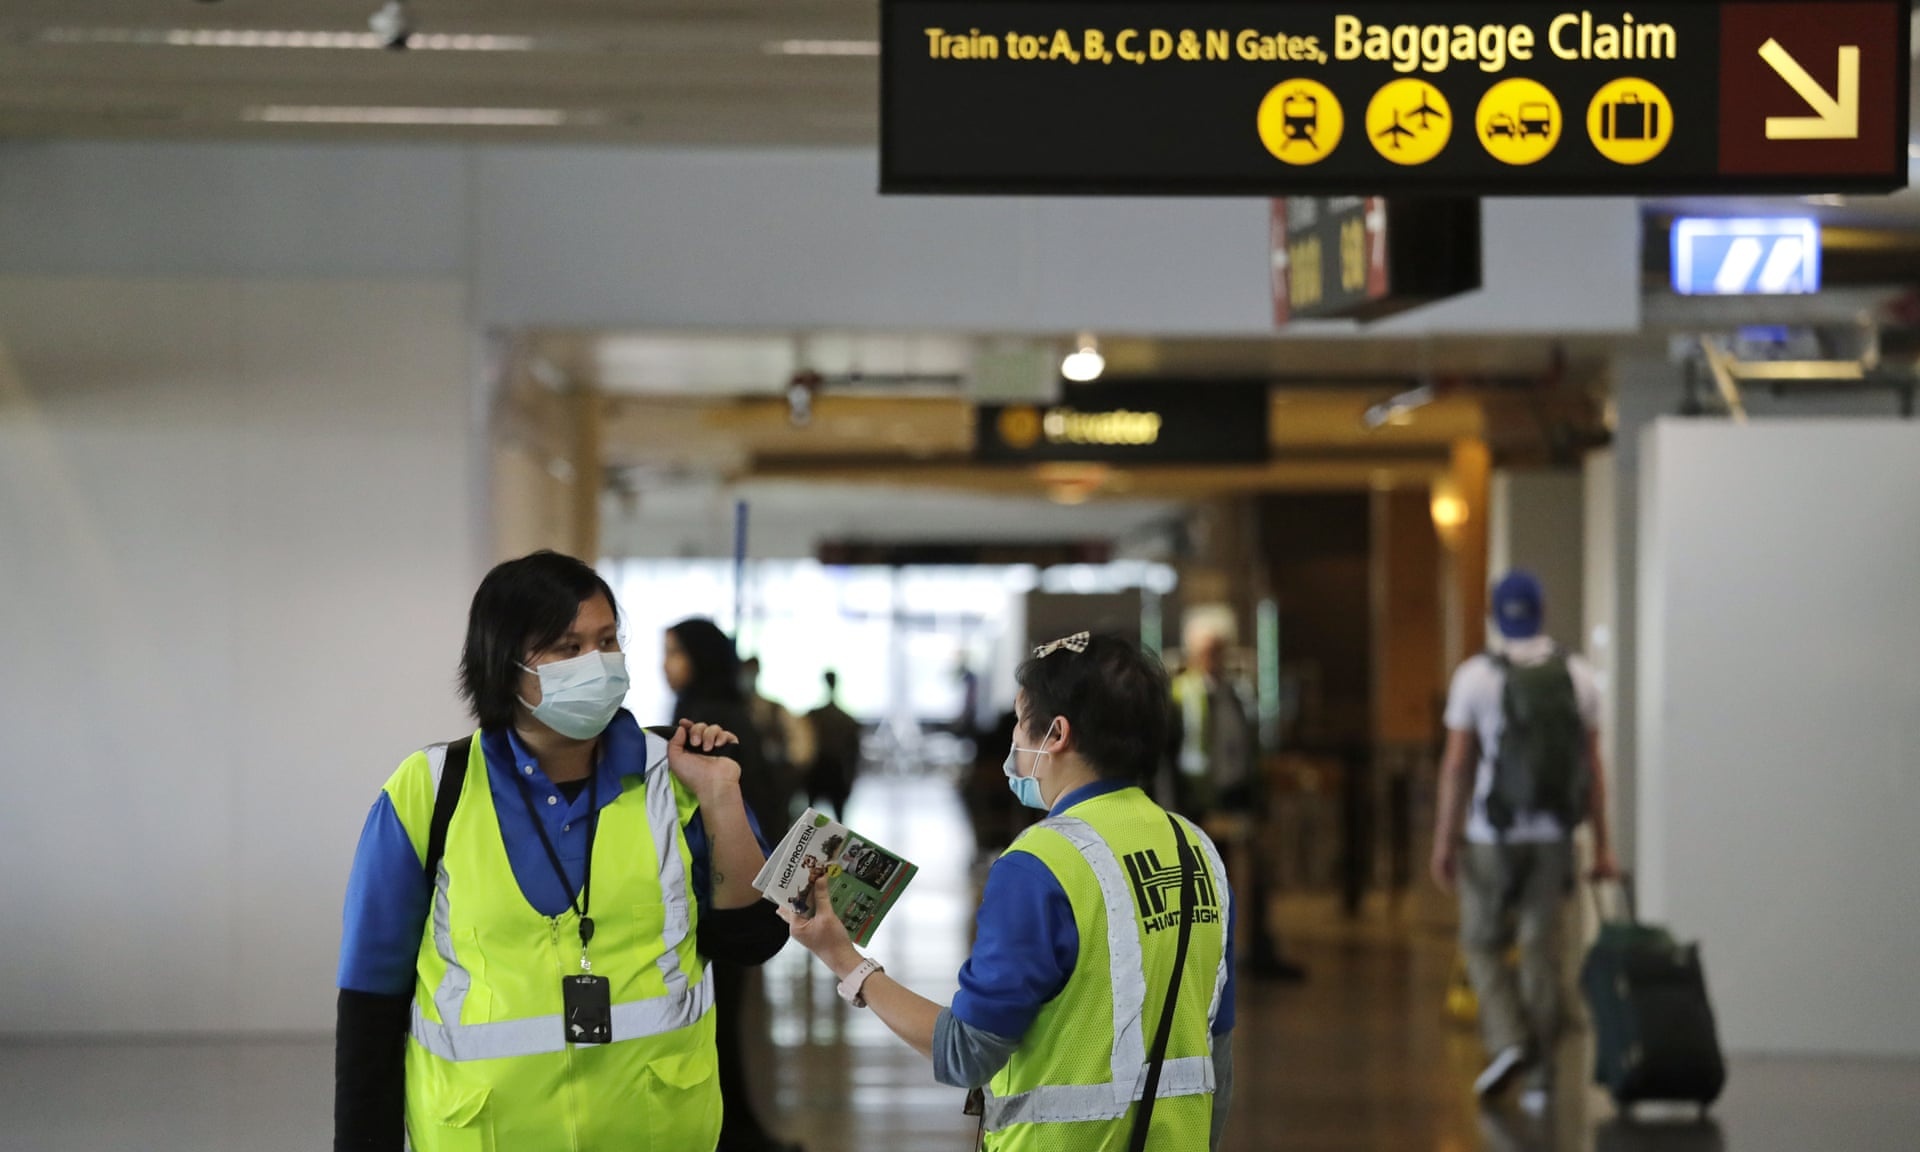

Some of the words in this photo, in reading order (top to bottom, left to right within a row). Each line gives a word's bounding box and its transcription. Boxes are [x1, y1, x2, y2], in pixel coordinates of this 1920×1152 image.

[924, 28, 999, 60] Train
[1149, 29, 1174, 60] D
[1176, 29, 1201, 60] &
[1205, 29, 1230, 60] N
[1235, 29, 1329, 64] Gates,
[1334, 14, 1535, 73] Baggage
[1548, 11, 1677, 60] Claim
[778, 863, 795, 889] HIGH
[790, 825, 815, 864] PROTEIN
